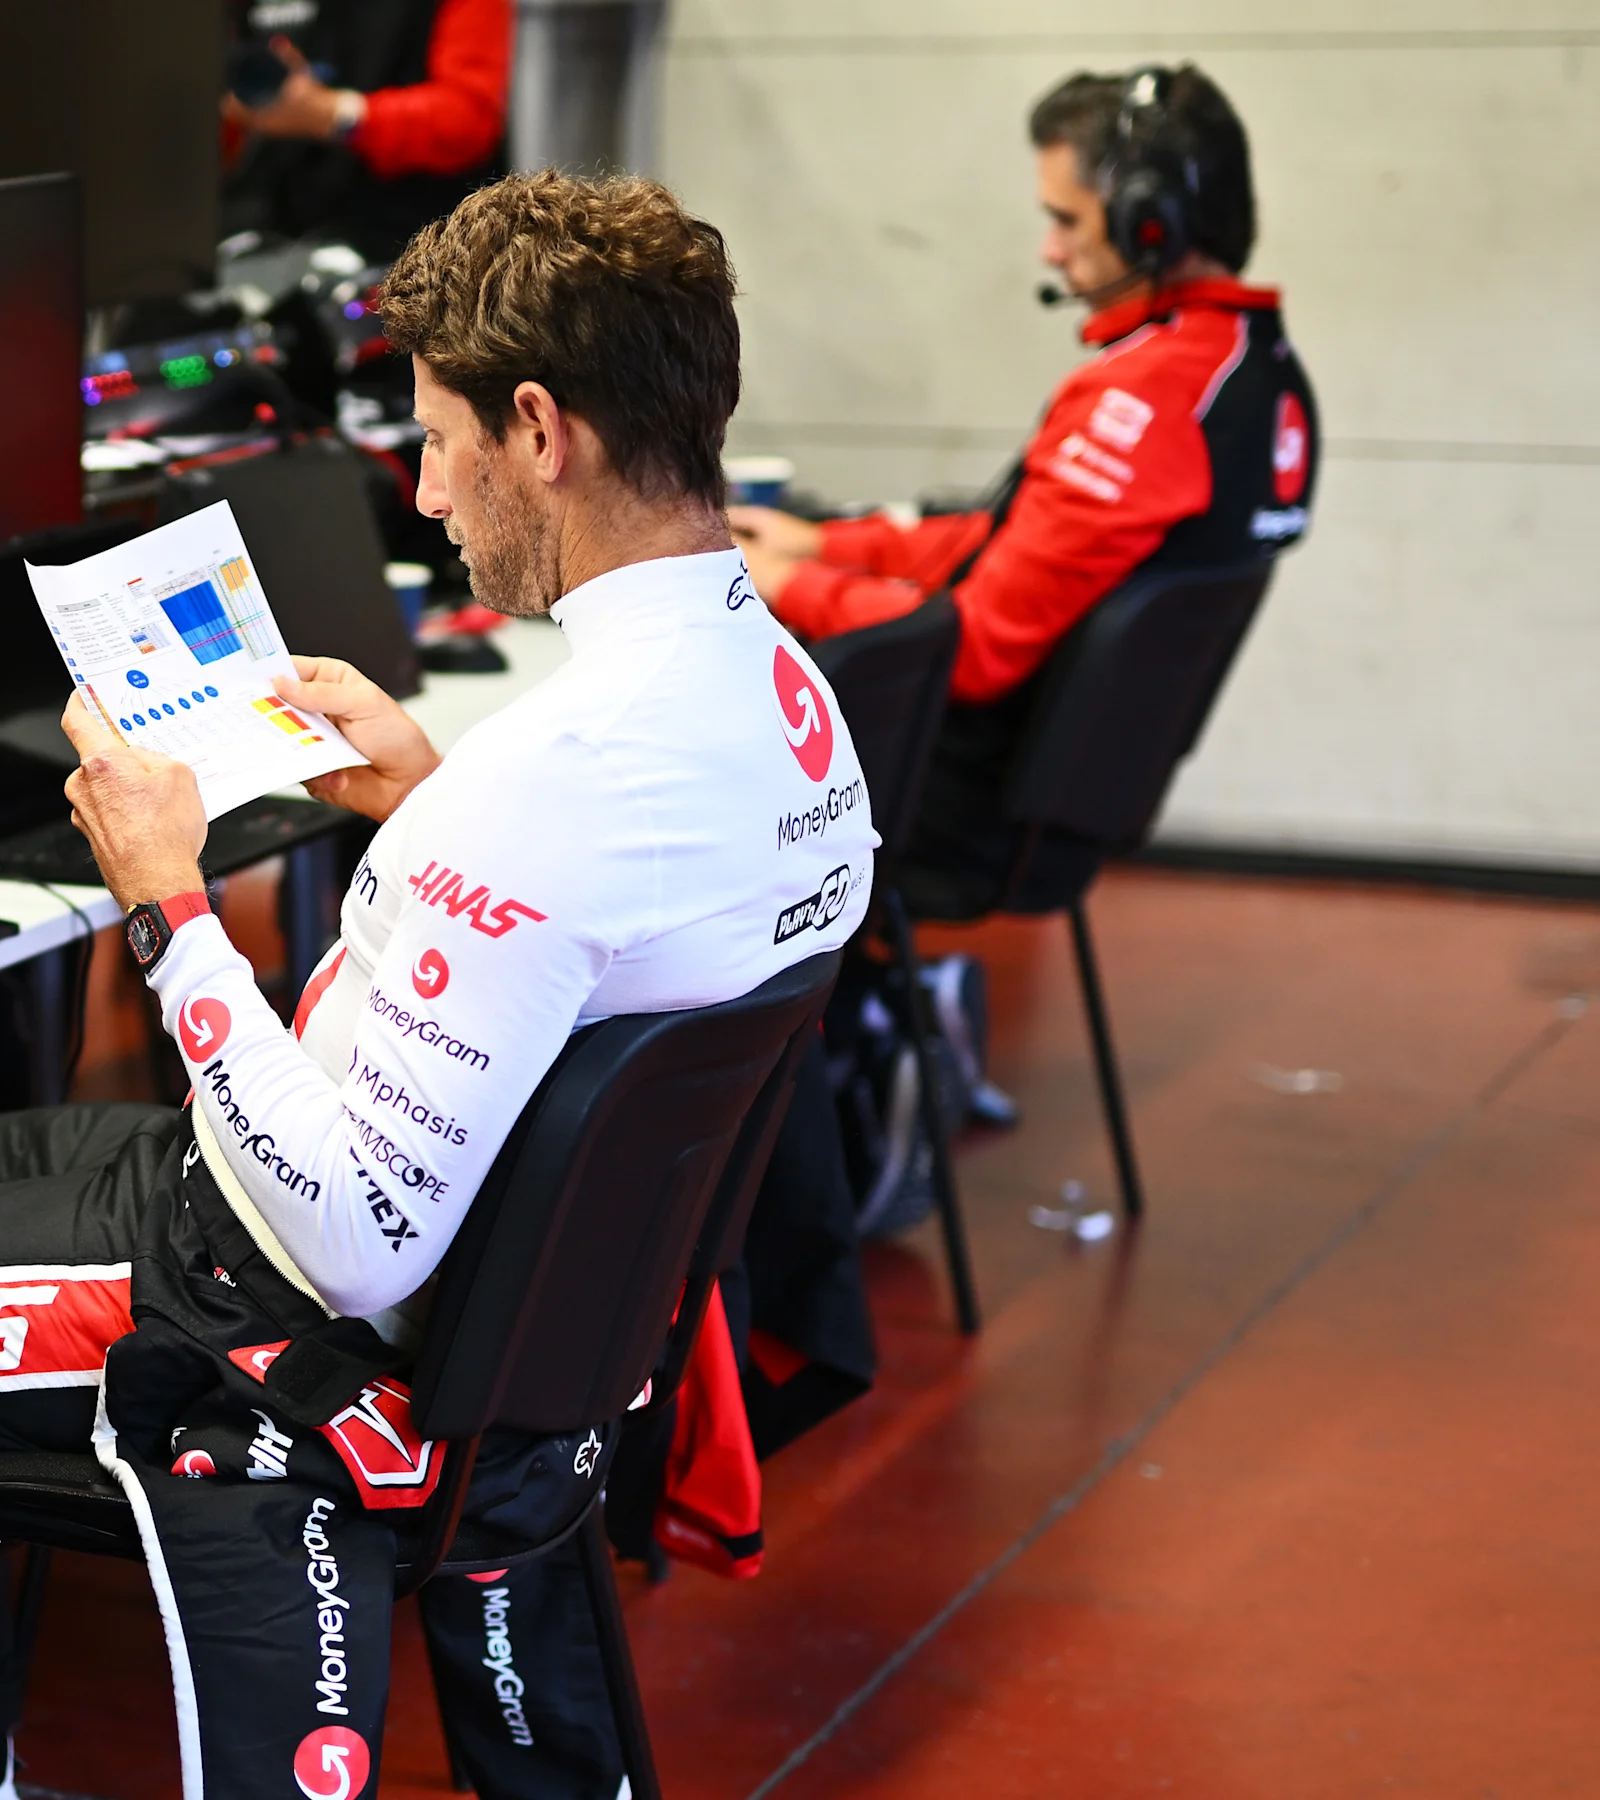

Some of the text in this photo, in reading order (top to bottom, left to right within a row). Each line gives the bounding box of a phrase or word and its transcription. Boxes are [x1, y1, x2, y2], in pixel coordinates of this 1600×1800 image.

[777, 777, 864, 851] MoneyGram
[408, 861, 549, 938] HAAS
[366, 985, 491, 1071] MoneyGram
[202, 1059, 321, 1202] MoneyGram
[356, 1064, 469, 1145] Mphasis
[302, 1497, 351, 1716] MoneyGram
[482, 1587, 534, 1746] MoneyGram
